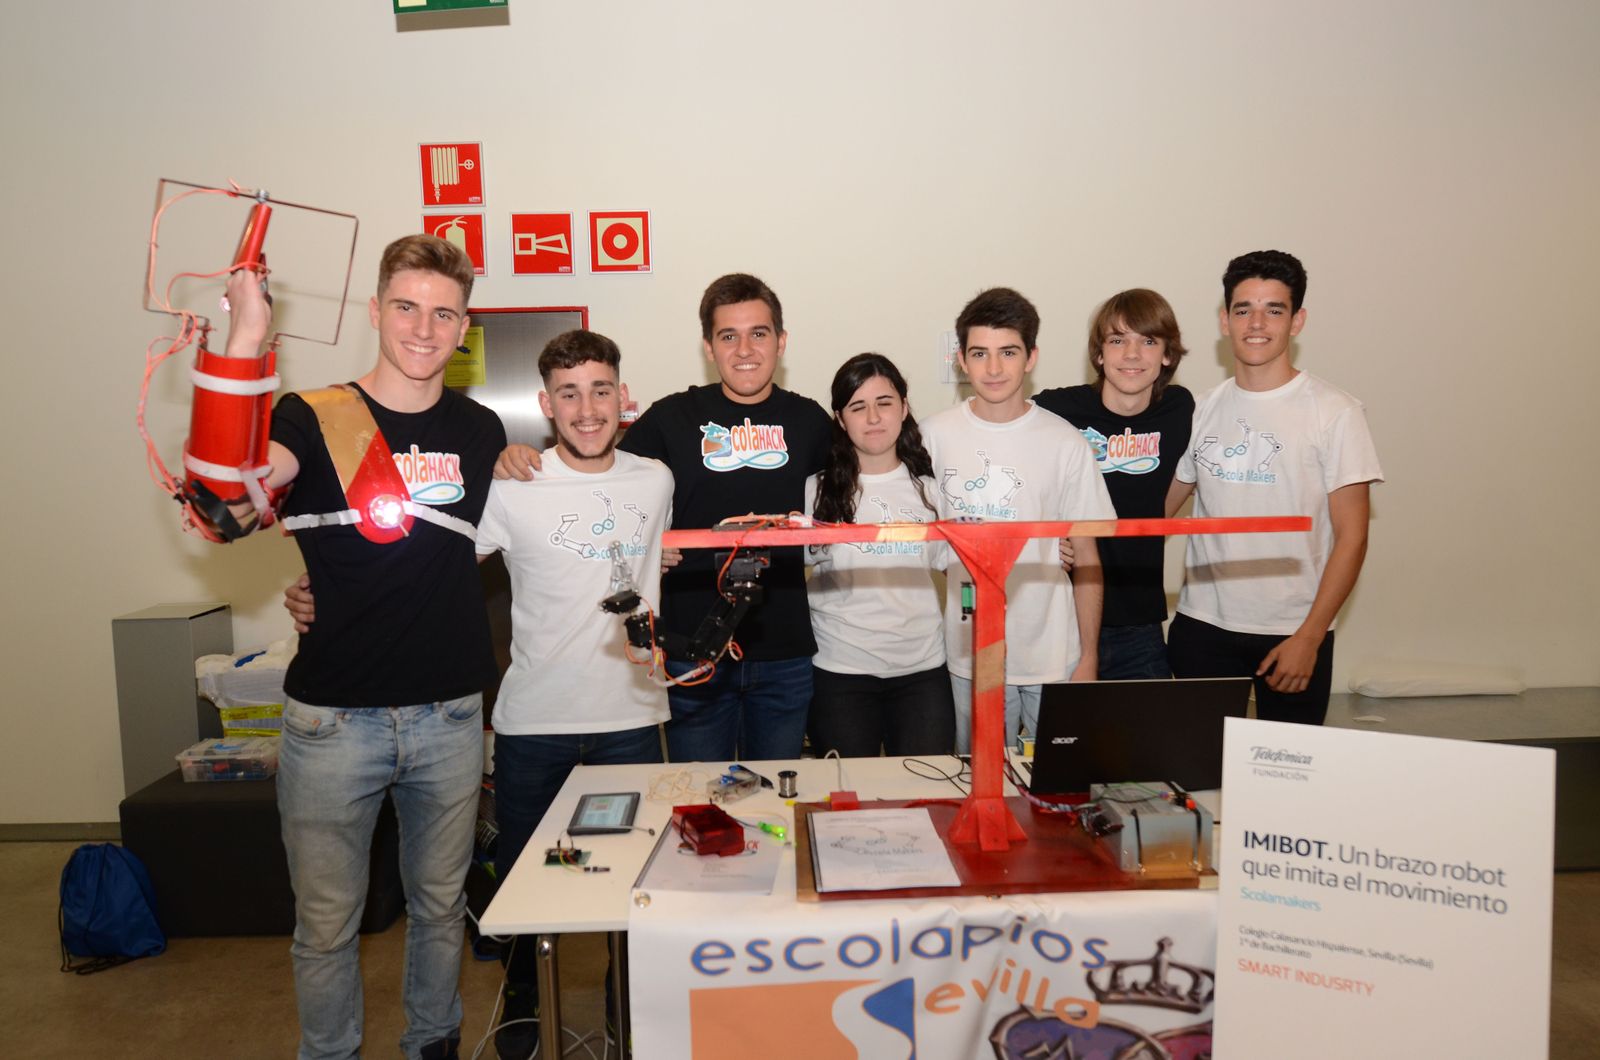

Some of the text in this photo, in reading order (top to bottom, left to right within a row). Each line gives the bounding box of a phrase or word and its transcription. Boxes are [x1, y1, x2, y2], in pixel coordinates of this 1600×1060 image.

[1241, 859, 1508, 915] que imita el movimiento
[1243, 830, 1507, 888] IMIBOT. Un brazo robot
[690, 915, 1109, 977] escolapios
[1237, 958, 1291, 980] SMART
